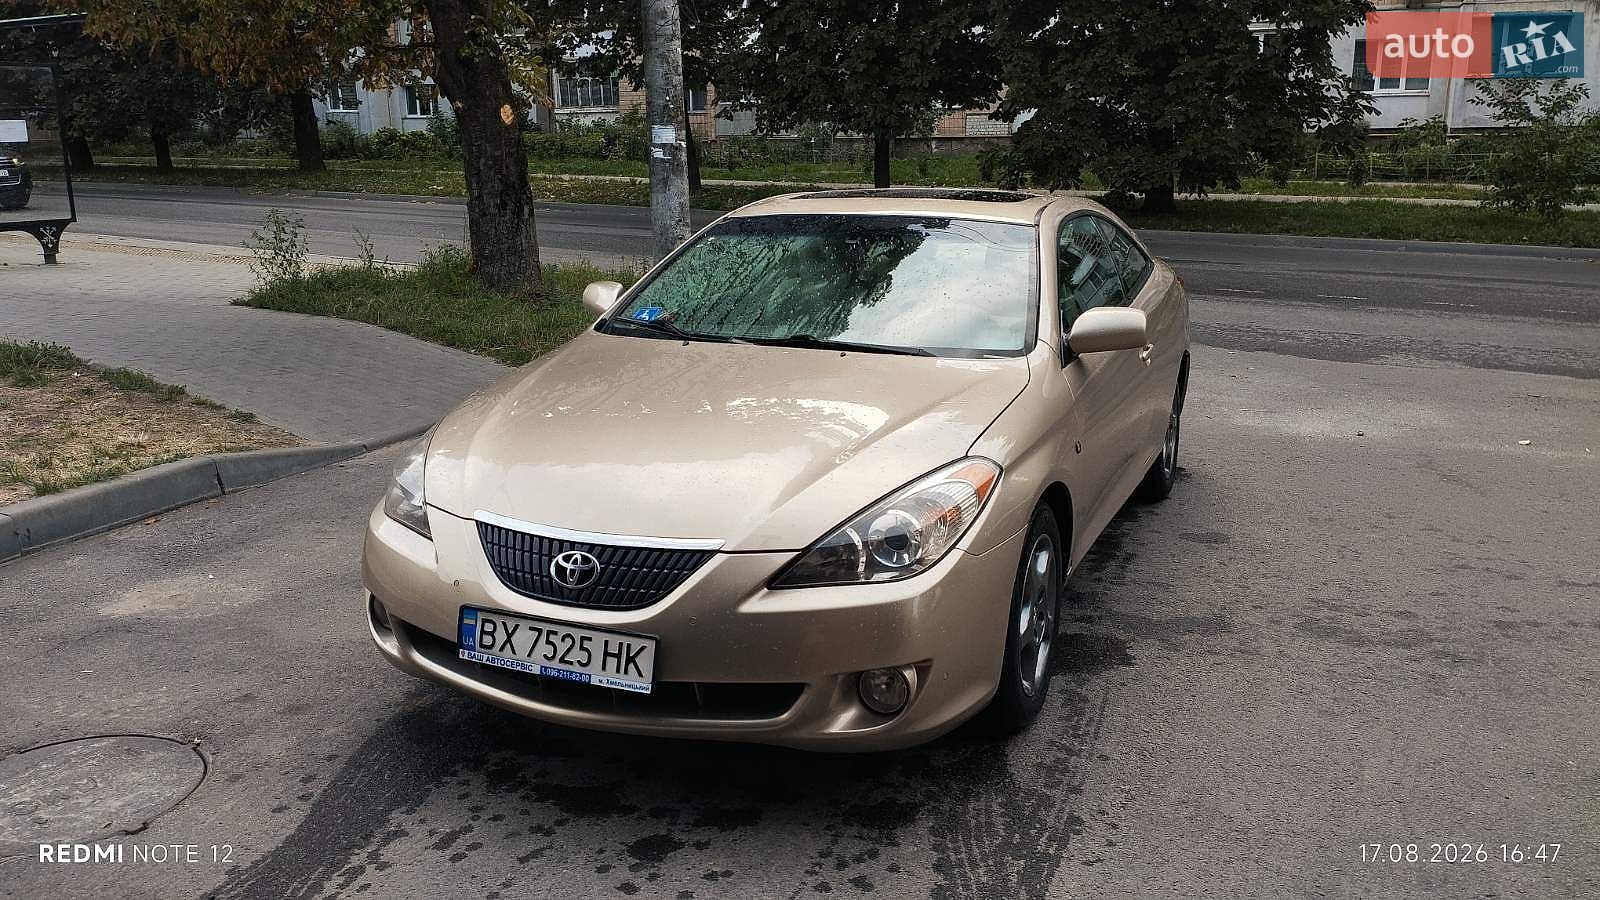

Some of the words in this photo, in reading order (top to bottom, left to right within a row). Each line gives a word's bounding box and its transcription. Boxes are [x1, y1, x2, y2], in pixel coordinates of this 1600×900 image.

[462, 635, 474, 647] UA
[479, 617, 520, 655] BX
[527, 626, 592, 667] 7525
[601, 639, 648, 678] HK
[467, 651, 484, 662] ВАШ
[486, 656, 533, 671] АВТОСЕРВІС
